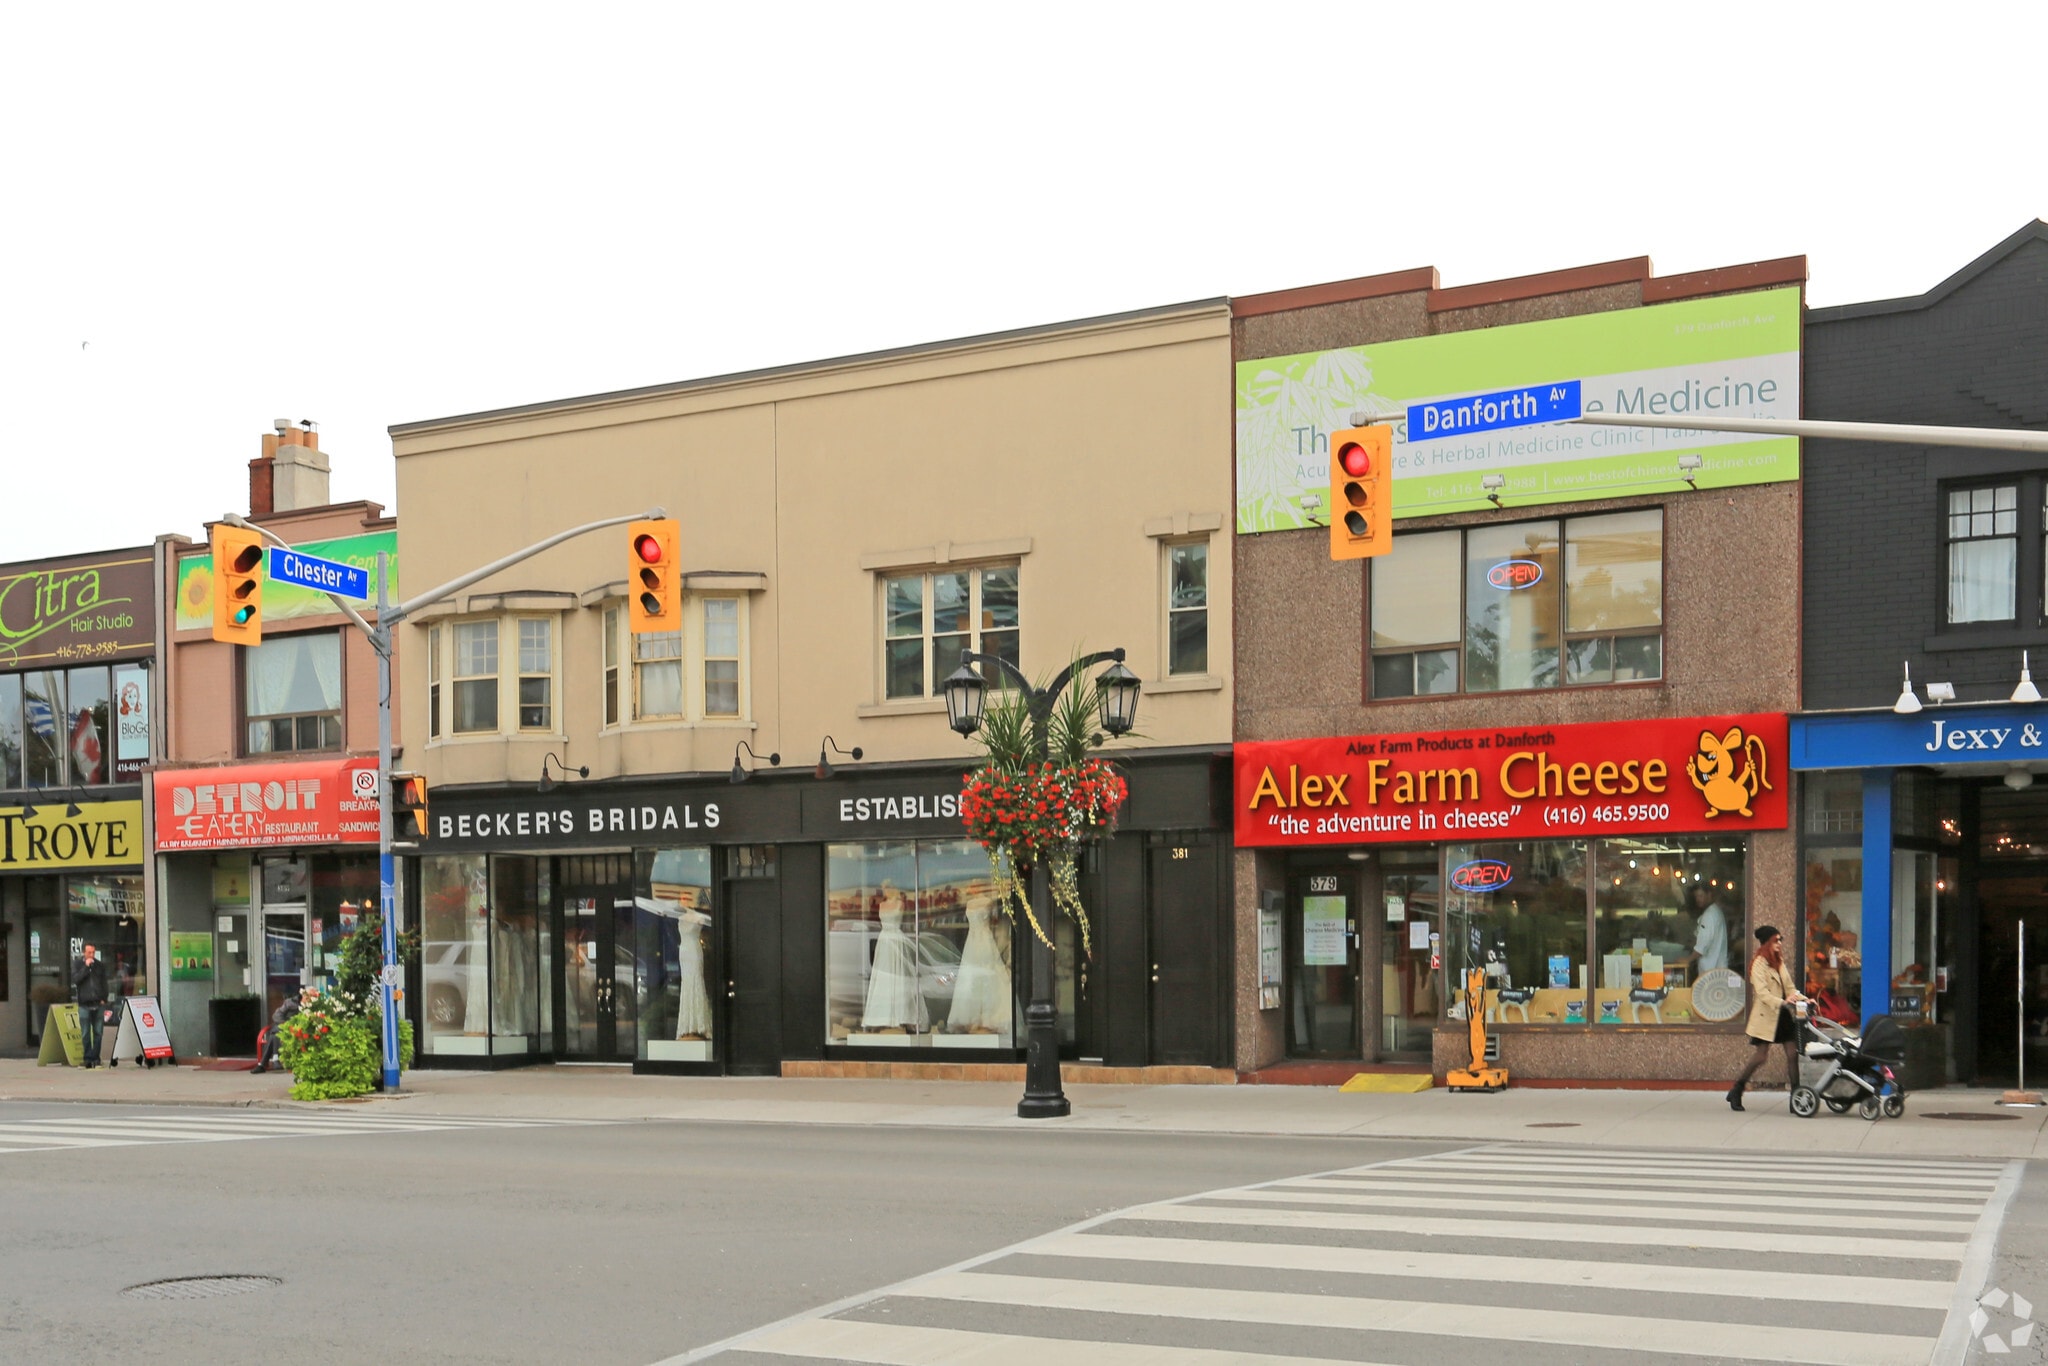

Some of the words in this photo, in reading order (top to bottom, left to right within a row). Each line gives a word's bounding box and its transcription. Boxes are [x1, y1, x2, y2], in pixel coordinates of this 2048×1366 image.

[1753, 313, 1777, 324] Ave
[1616, 376, 1777, 414] Medicine
[1423, 391, 1537, 432] Danforth
[1550, 387, 1566, 401] Av
[1291, 425, 1328, 455] Th
[1414, 451, 1425, 466] &
[1432, 442, 1491, 464] Herbal
[1498, 435, 1584, 457] Medicine
[1591, 427, 1644, 447] Clinic
[1553, 454, 1778, 485] www.bestofchinesedicine.com
[284, 554, 342, 588] Chester
[347, 570, 358, 582] Av
[1490, 565, 1536, 585] OPEN
[0, 570, 99, 638] Citra
[70, 617, 94, 633] Hair
[96, 613, 133, 631] Studio
[56, 641, 118, 659] 416-778-9585
[1346, 742, 1375, 756] Alex
[1380, 740, 1413, 754] Farm
[1417, 737, 1473, 751] Products
[1478, 737, 1490, 748] at
[1495, 731, 1555, 748] Danforth
[1925, 720, 2012, 752] Jexy
[2020, 723, 2042, 747] &
[1249, 764, 1350, 809] Alex
[1367, 758, 1479, 804] Farm
[1499, 751, 1668, 799] Cheese
[173, 779, 321, 816] DETROIT
[340, 800, 380, 812] BREAKFA
[175, 813, 267, 838] EATERY
[265, 821, 319, 834] RESTAURANT
[338, 822, 380, 832] SANDWIC
[439, 809, 574, 838] BECKER'S
[589, 803, 721, 832] BRIDALS
[1316, 812, 1412, 834] adventure
[1419, 809, 1437, 830] in
[1543, 805, 1587, 827] (416)
[1592, 803, 1670, 823] 465.9500
[0, 814, 129, 862] TROVE
[1172, 847, 1188, 860] 381
[1311, 877, 1336, 890] 379
[1452, 864, 1511, 885] OPEN
